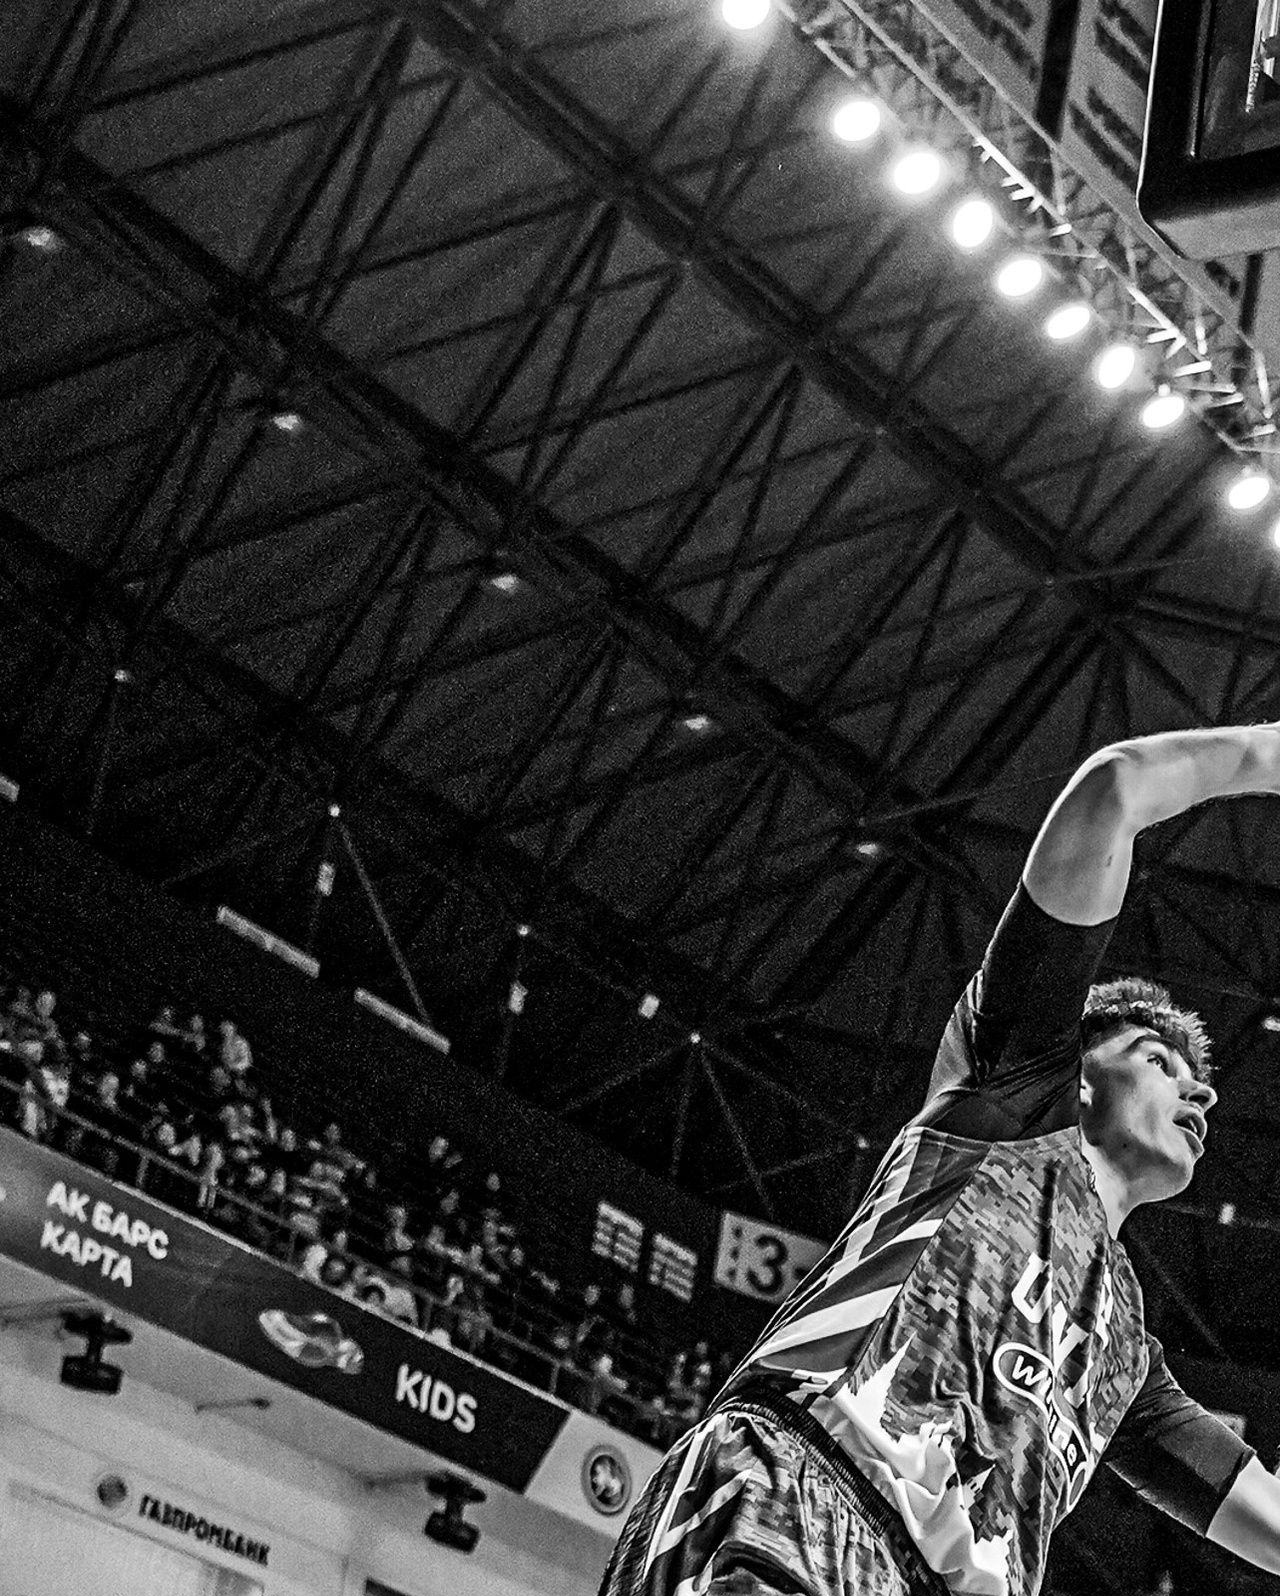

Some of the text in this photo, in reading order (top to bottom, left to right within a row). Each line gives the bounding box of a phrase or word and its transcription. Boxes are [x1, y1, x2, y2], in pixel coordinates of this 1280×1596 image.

[40, 1219, 133, 1289] КАРТА
[46, 1180, 169, 1260] АК БАРС
[396, 1362, 478, 1434] KIDS
[138, 1493, 272, 1569] ГАЗПРОМБАНК
